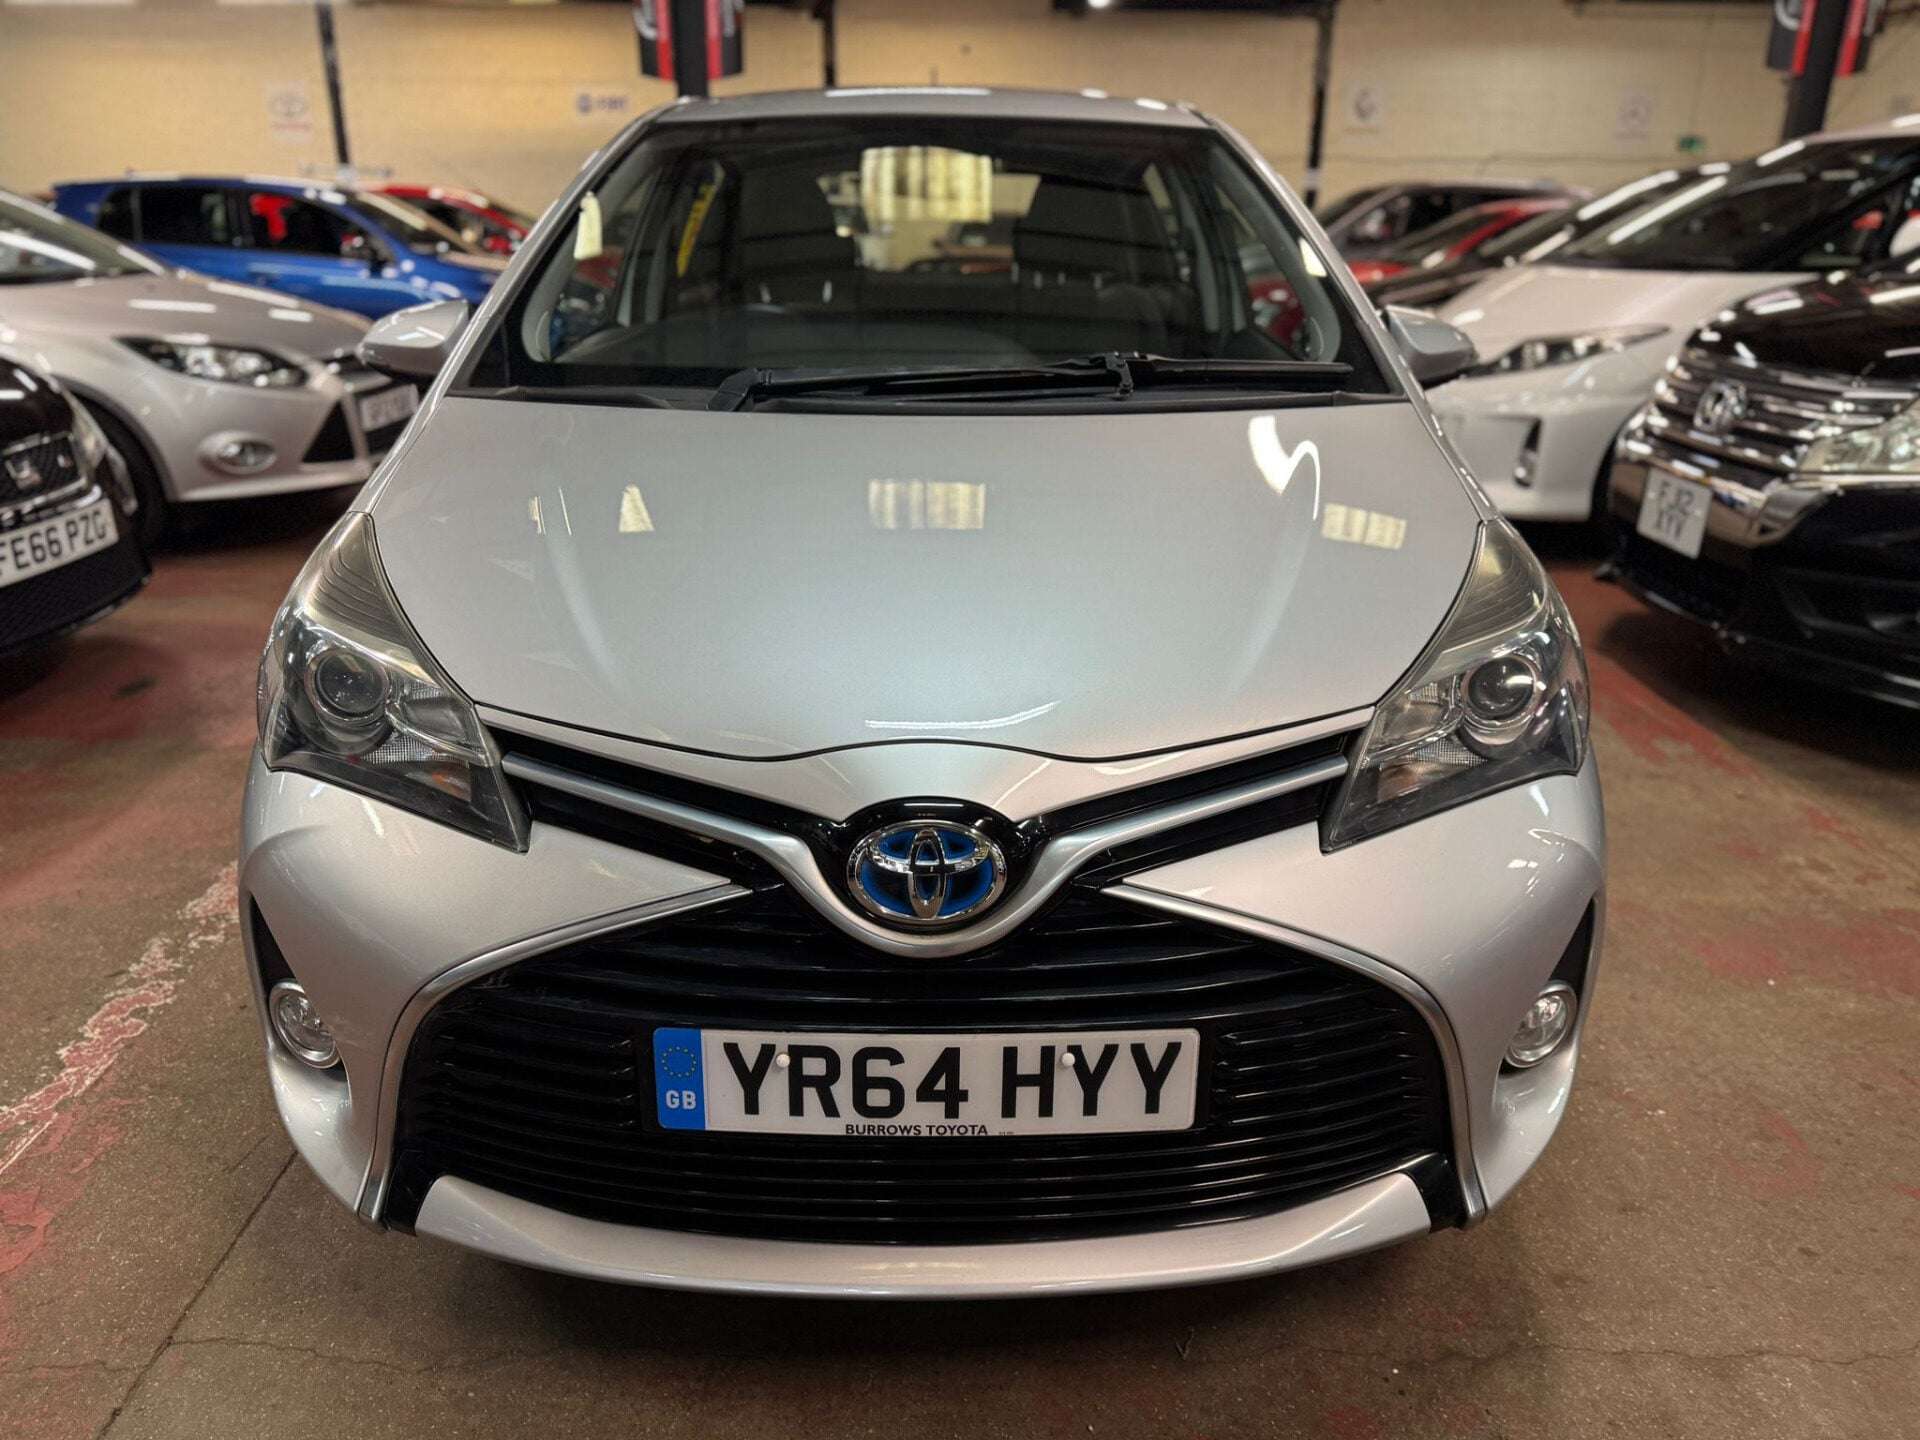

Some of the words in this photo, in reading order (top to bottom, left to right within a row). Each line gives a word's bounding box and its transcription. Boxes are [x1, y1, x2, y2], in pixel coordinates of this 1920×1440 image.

[723, 1042, 969, 1119] YR64
[1001, 1041, 1182, 1118] HYY
[665, 1090, 696, 1110] GB
[845, 1124, 921, 1136] BURROWS
[926, 1124, 988, 1136] TOYOTA
